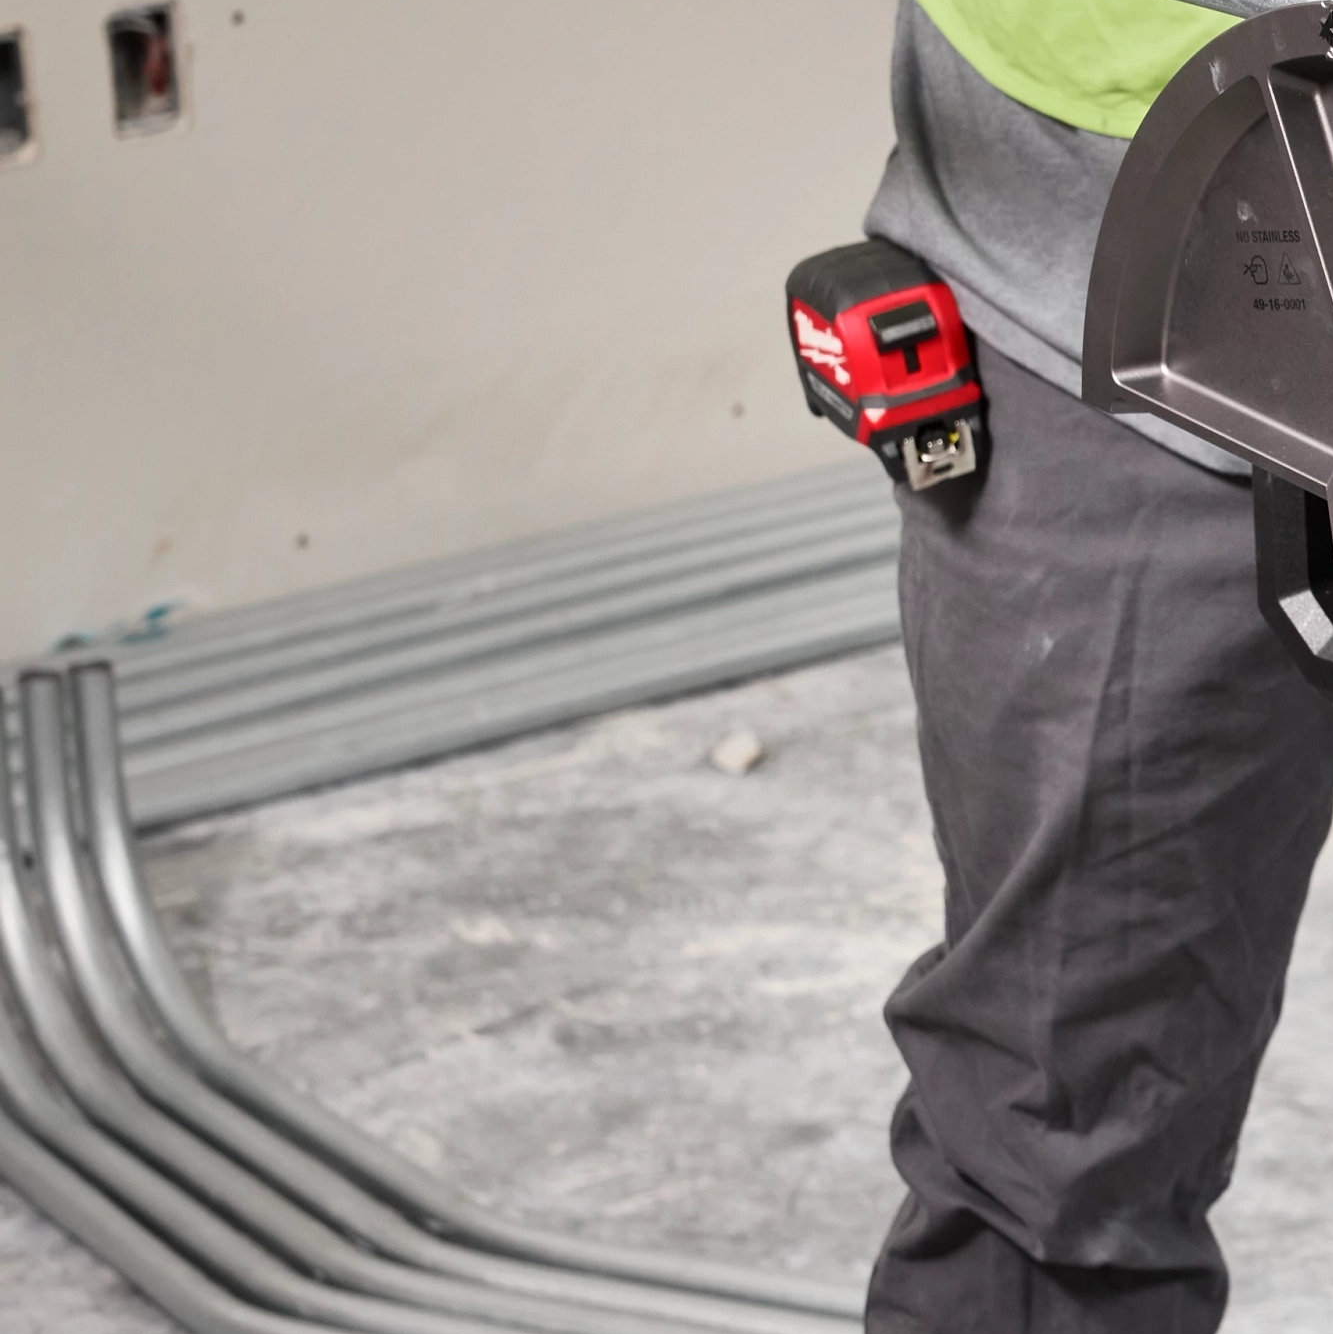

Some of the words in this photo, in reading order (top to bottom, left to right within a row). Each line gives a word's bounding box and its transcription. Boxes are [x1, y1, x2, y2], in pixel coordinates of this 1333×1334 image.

[1236, 231, 1250, 243] NO
[1251, 230, 1301, 243] STAINLESS
[1253, 298, 1307, 311] 49-16-0001
